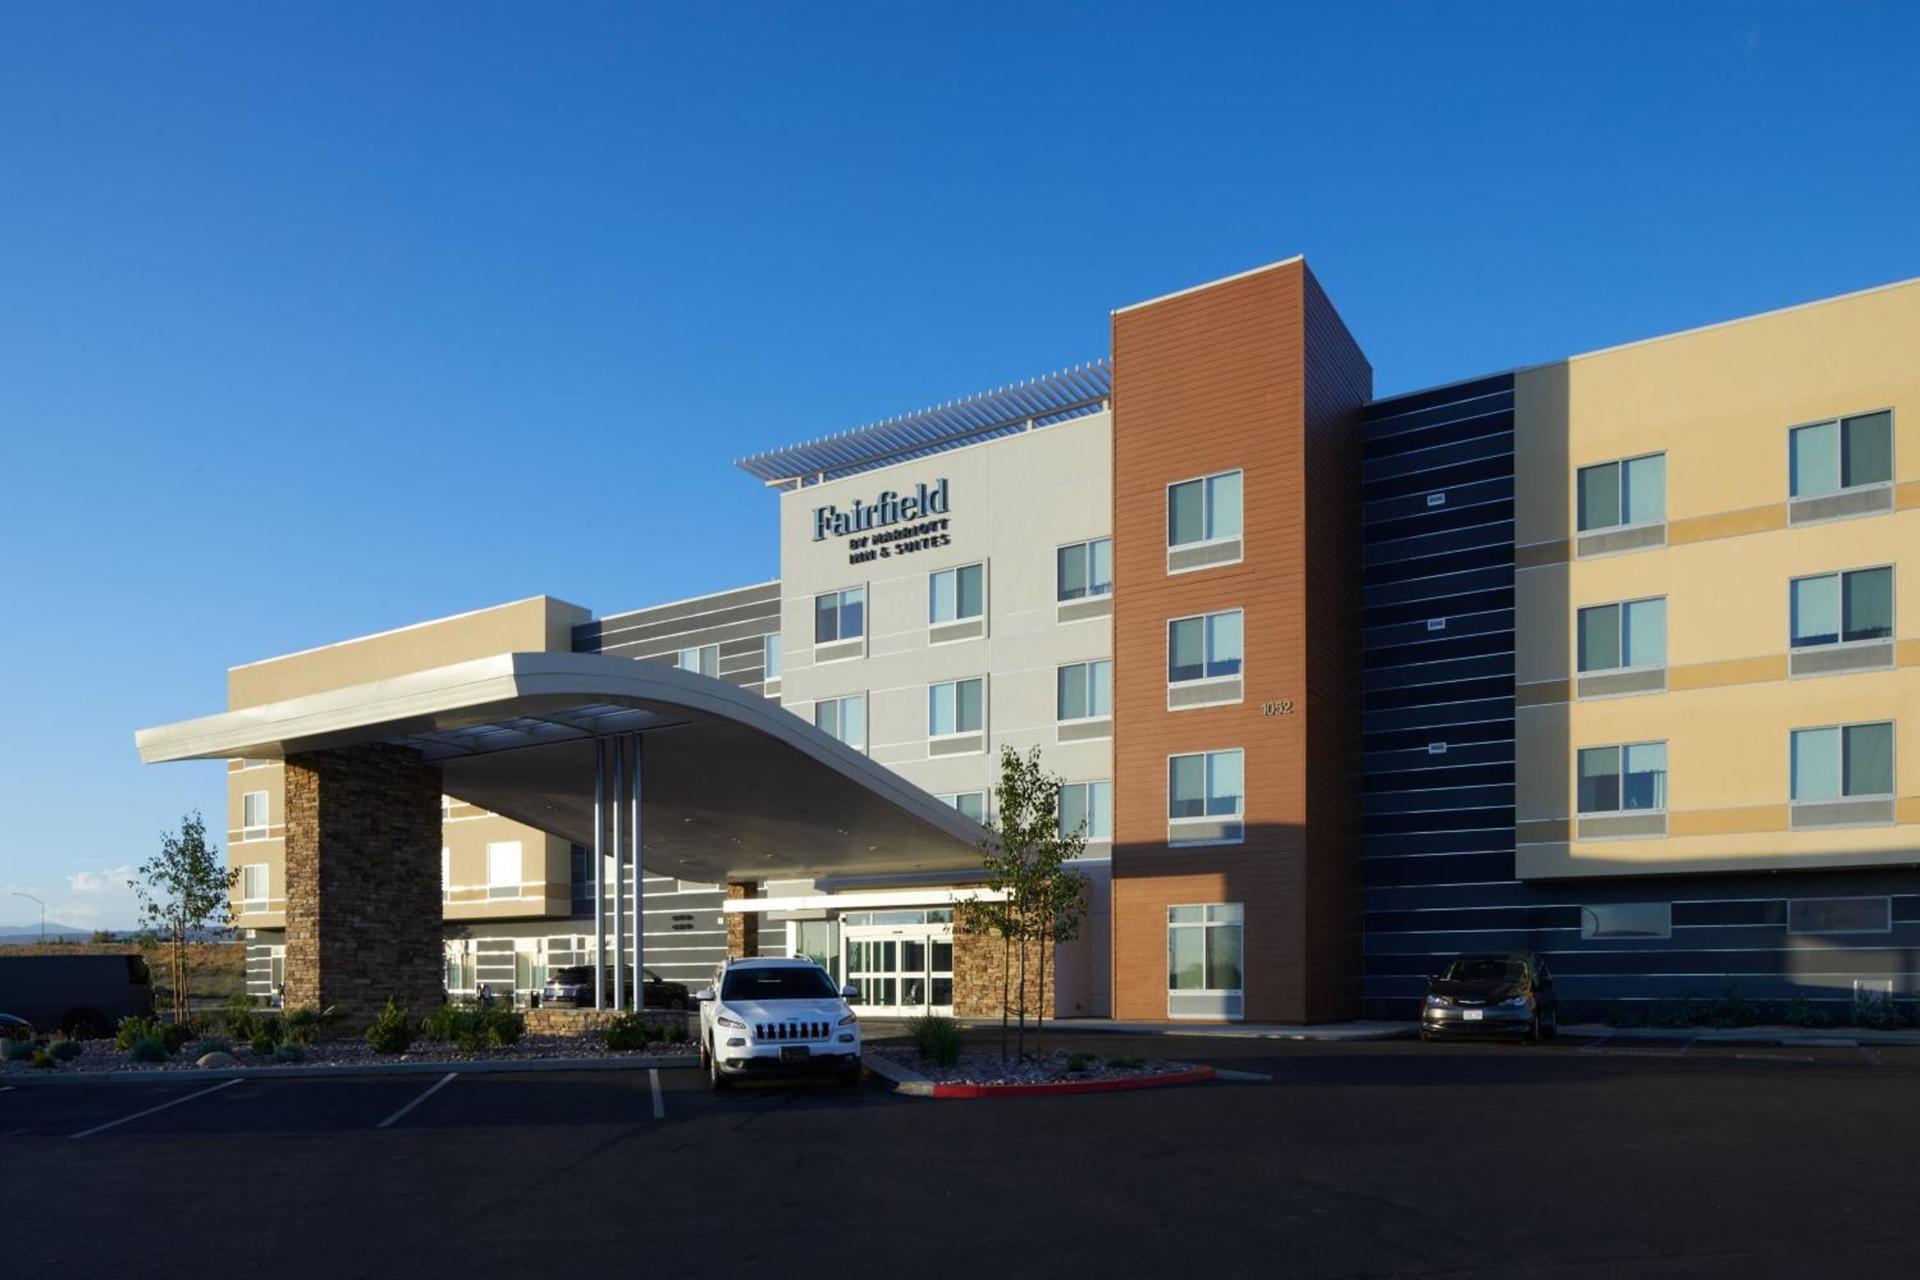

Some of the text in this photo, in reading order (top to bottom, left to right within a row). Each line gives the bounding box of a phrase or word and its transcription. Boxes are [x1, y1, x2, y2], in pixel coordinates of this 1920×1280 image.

[812, 478, 950, 542] Fairfield
[849, 534, 951, 565] INN & SUITES
[850, 519, 951, 550] BY MARRIOTT
